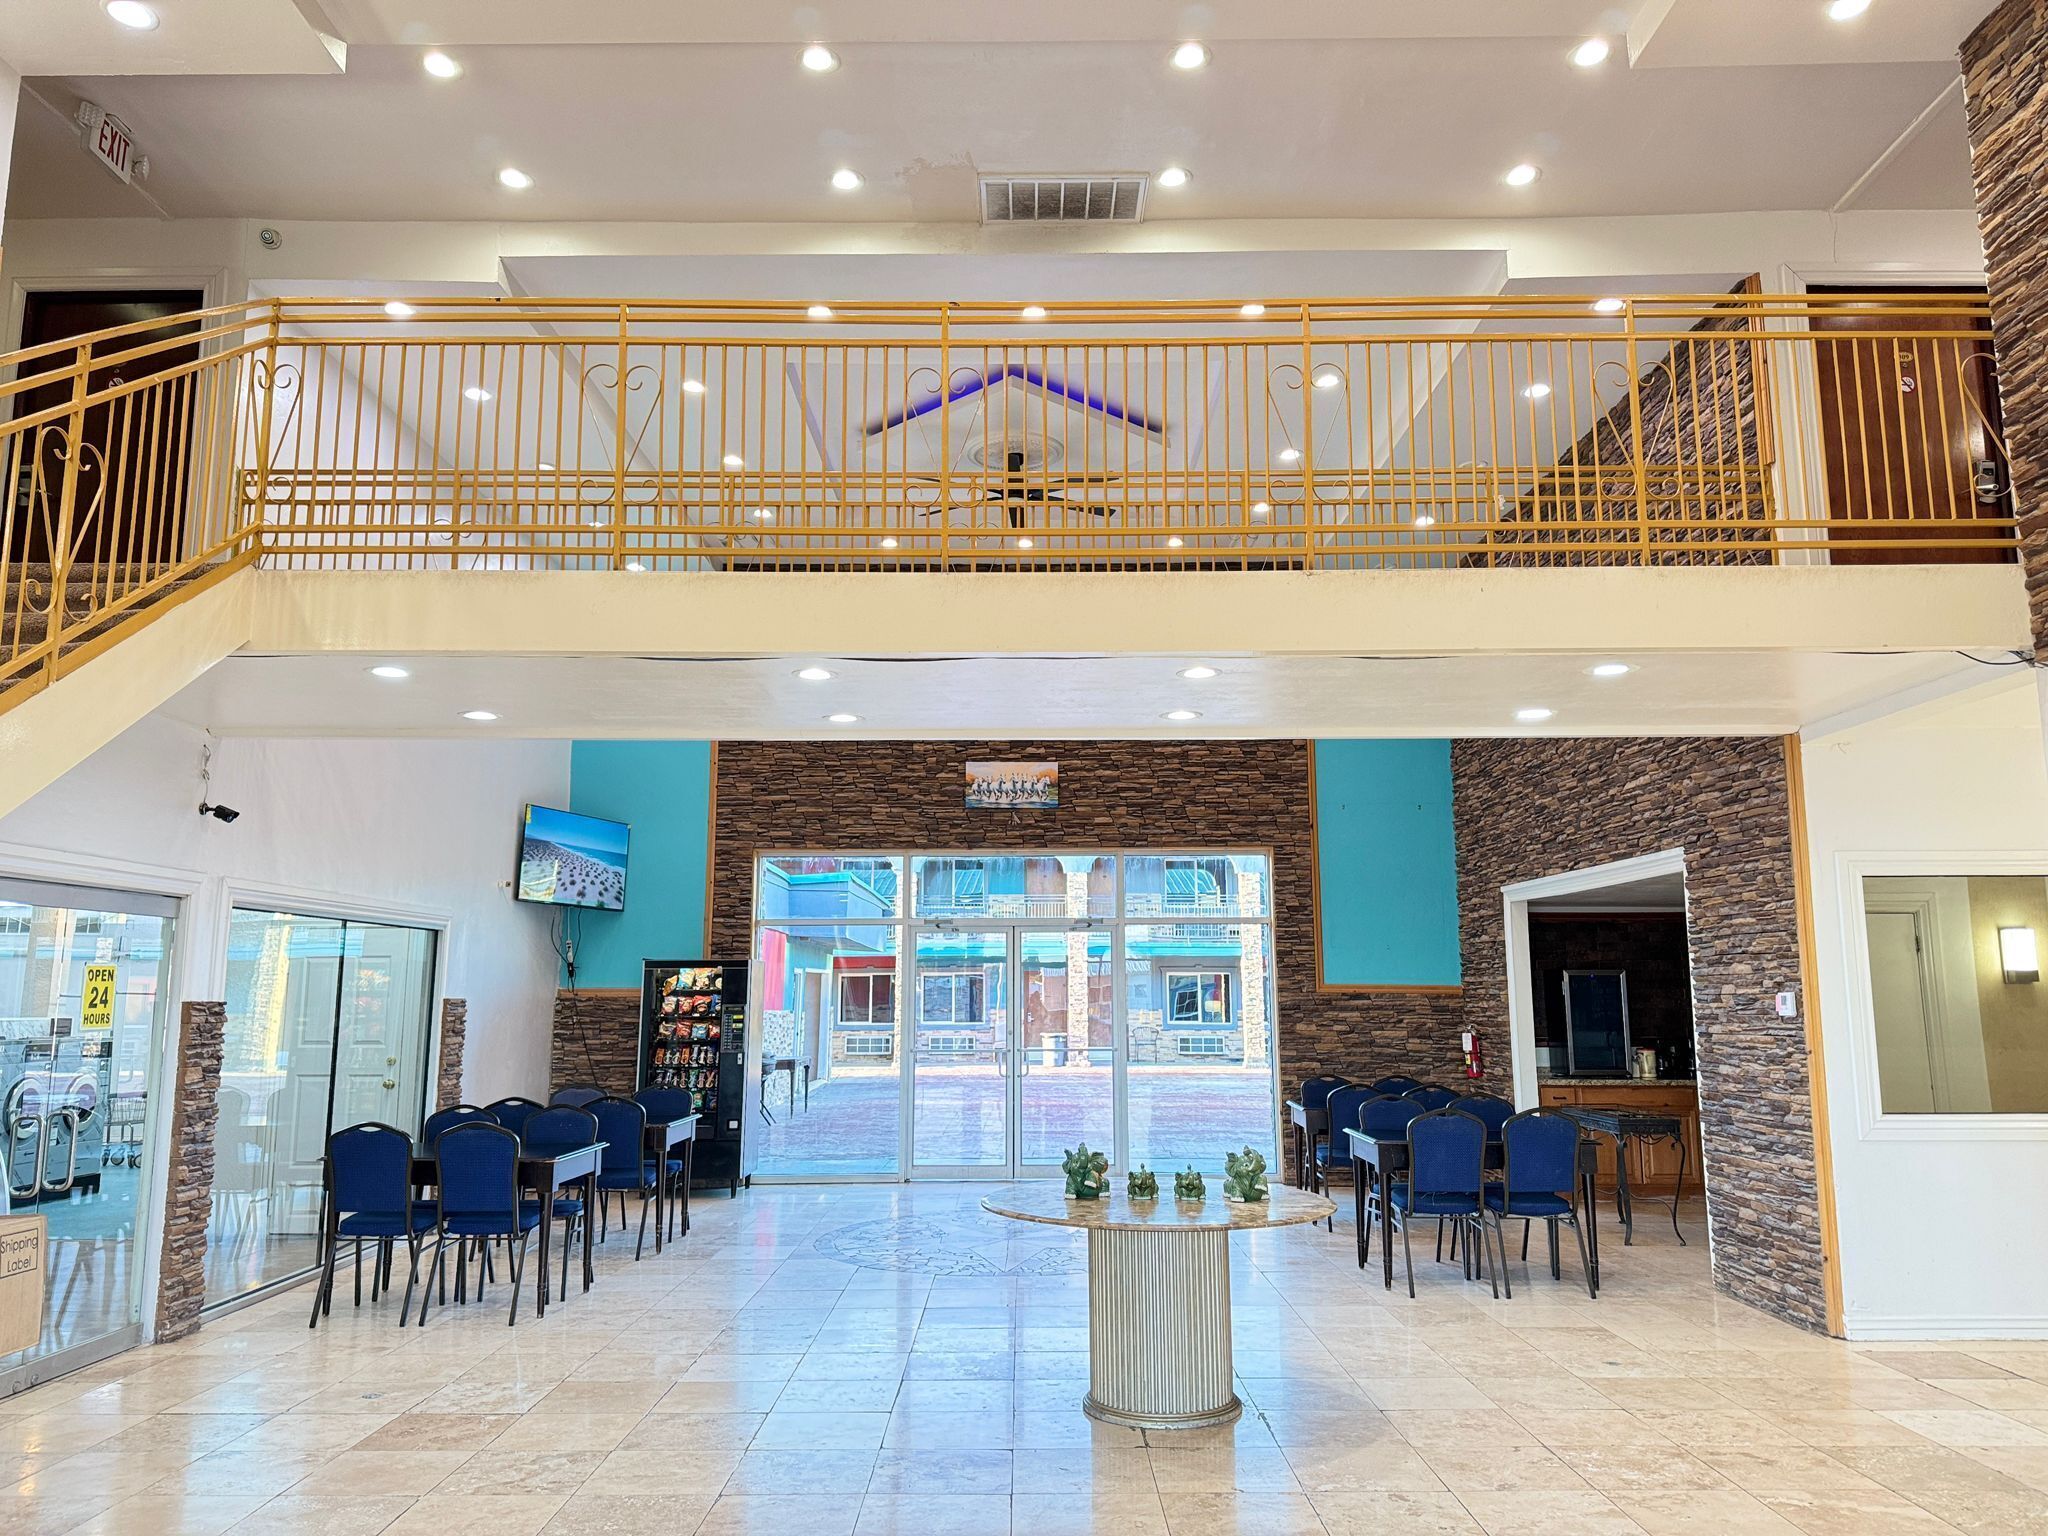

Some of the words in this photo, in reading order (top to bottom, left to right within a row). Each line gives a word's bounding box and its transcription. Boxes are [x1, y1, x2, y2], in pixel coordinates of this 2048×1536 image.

[98, 119, 130, 172] EXIT
[87, 969, 113, 982] OPEN
[88, 986, 108, 1009] 24
[83, 1013, 111, 1025] HOURS
[0, 1236, 38, 1254] Shipping
[7, 1256, 31, 1273] Label
